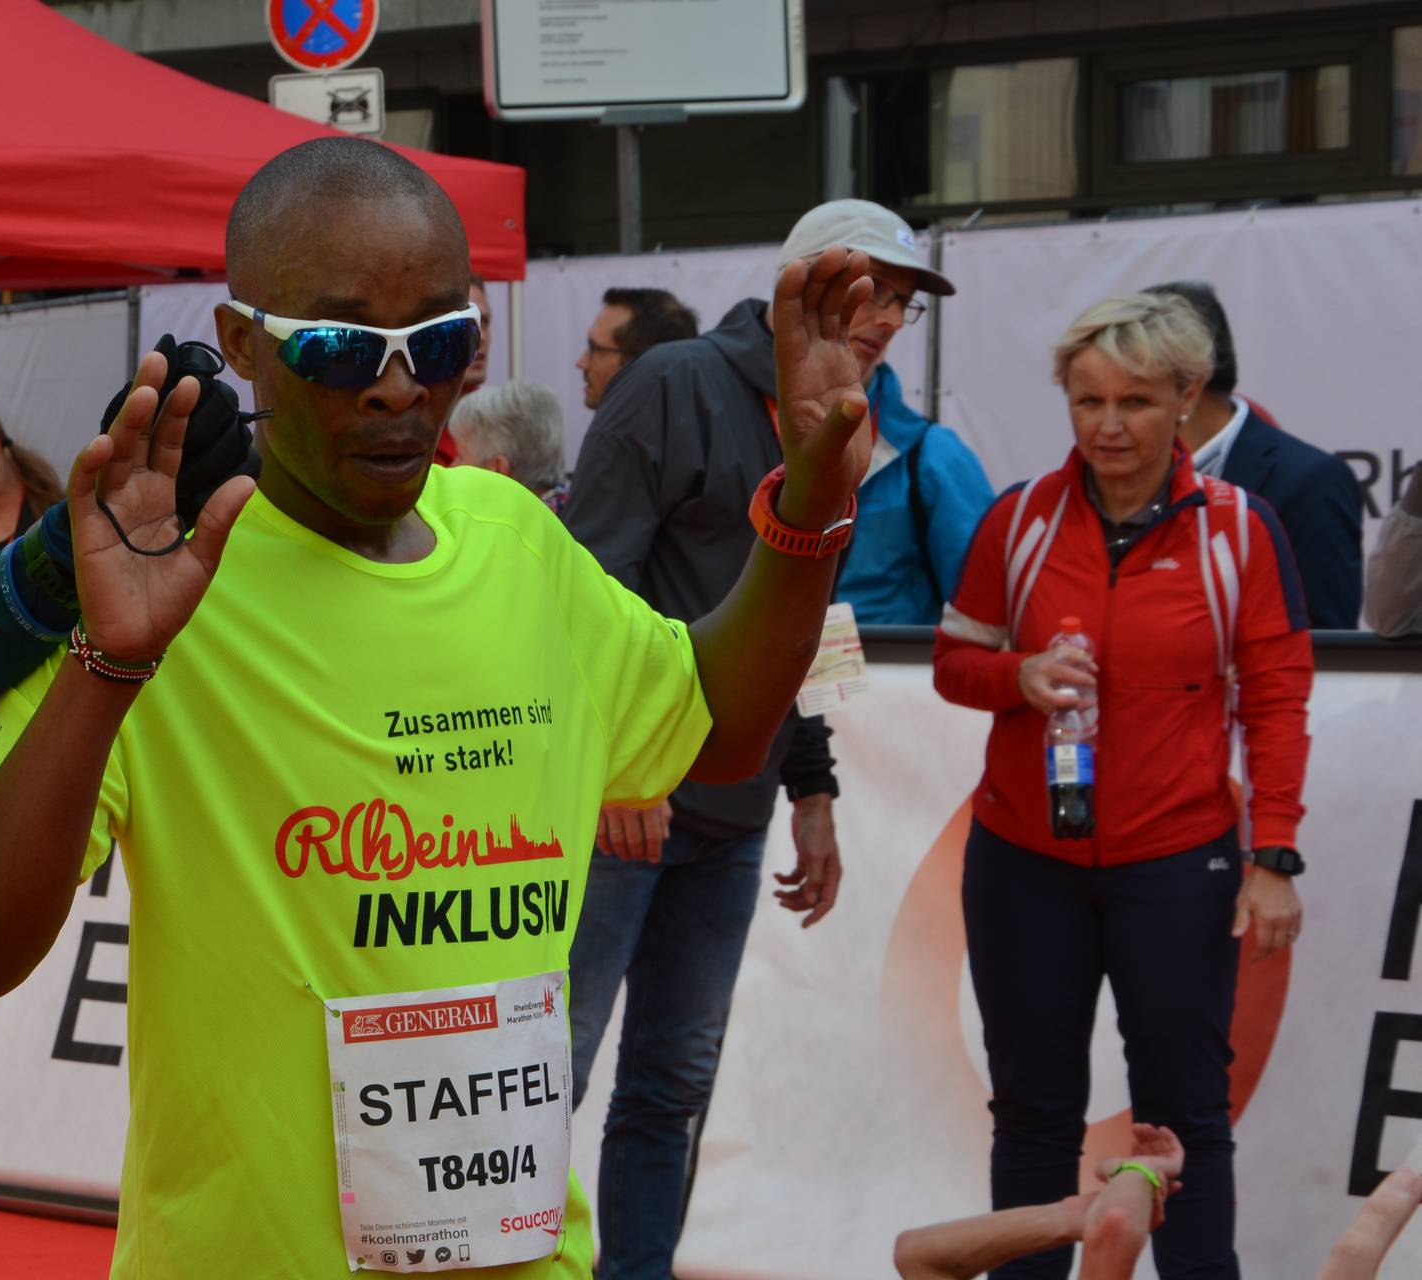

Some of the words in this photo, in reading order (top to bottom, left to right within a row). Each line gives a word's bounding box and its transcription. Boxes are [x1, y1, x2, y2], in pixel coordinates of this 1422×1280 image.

[385, 706, 523, 738] Zusammen
[528, 698, 552, 724] sind
[395, 748, 435, 775] wir
[444, 739, 514, 772] stark!
[275, 798, 480, 881] R(h)ein
[353, 879, 569, 948] INKLUSIV
[385, 1001, 495, 1034] GENERALI
[359, 1062, 560, 1127] STAFFEL
[419, 1144, 537, 1193] T849/4
[361, 1229, 468, 1245] #koelnmarathon
